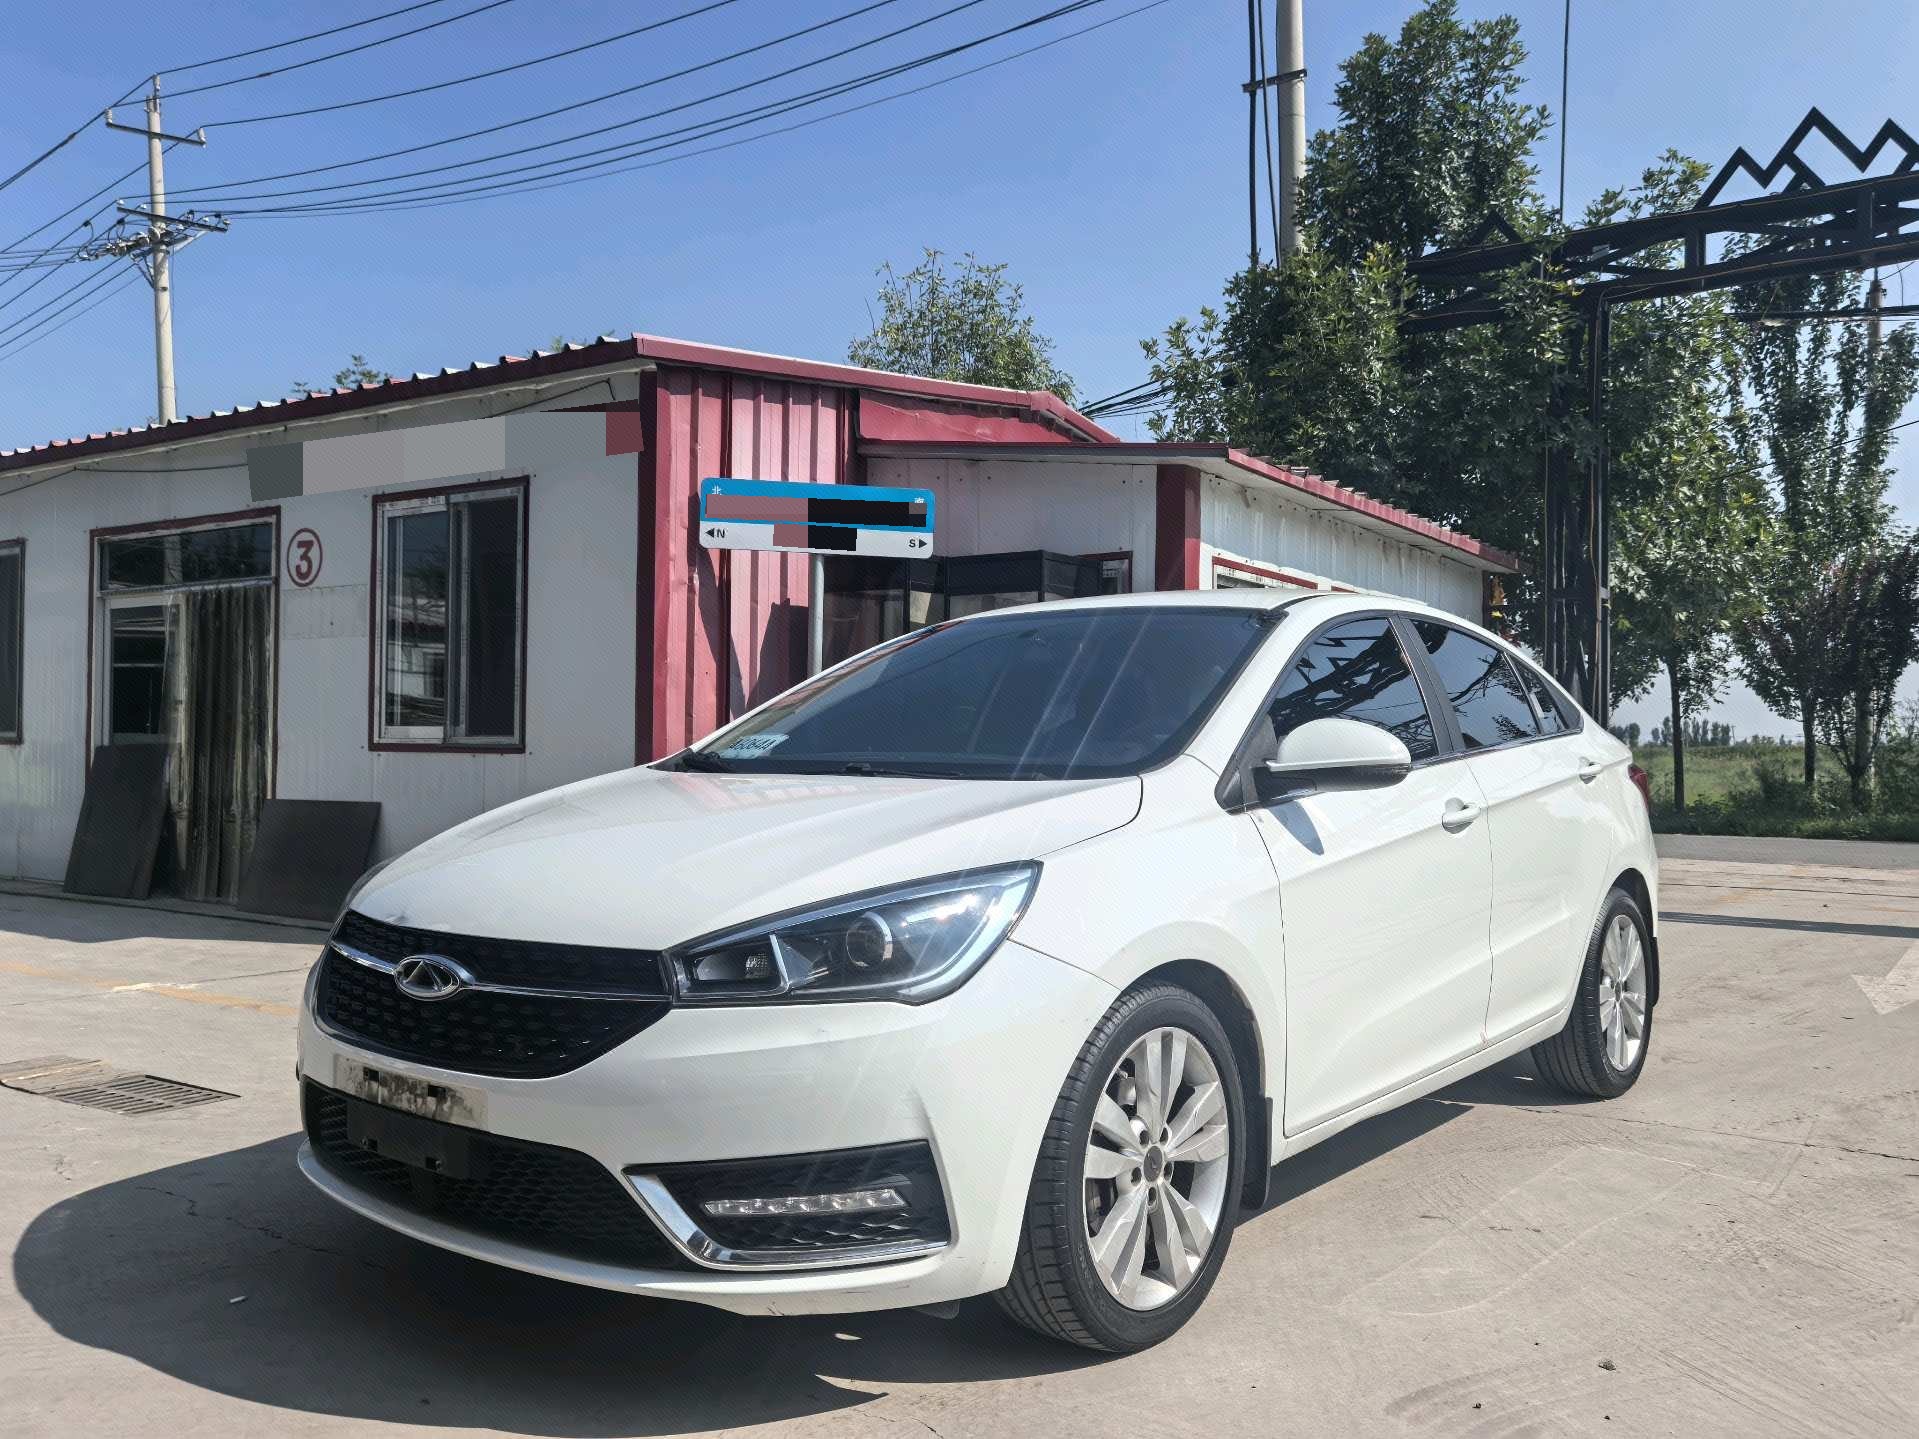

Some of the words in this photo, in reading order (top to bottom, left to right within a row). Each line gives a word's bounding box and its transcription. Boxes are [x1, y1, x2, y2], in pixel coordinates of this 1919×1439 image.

[716, 528, 726, 539] N
[908, 538, 916, 548] S
[296, 540, 313, 580] 3
